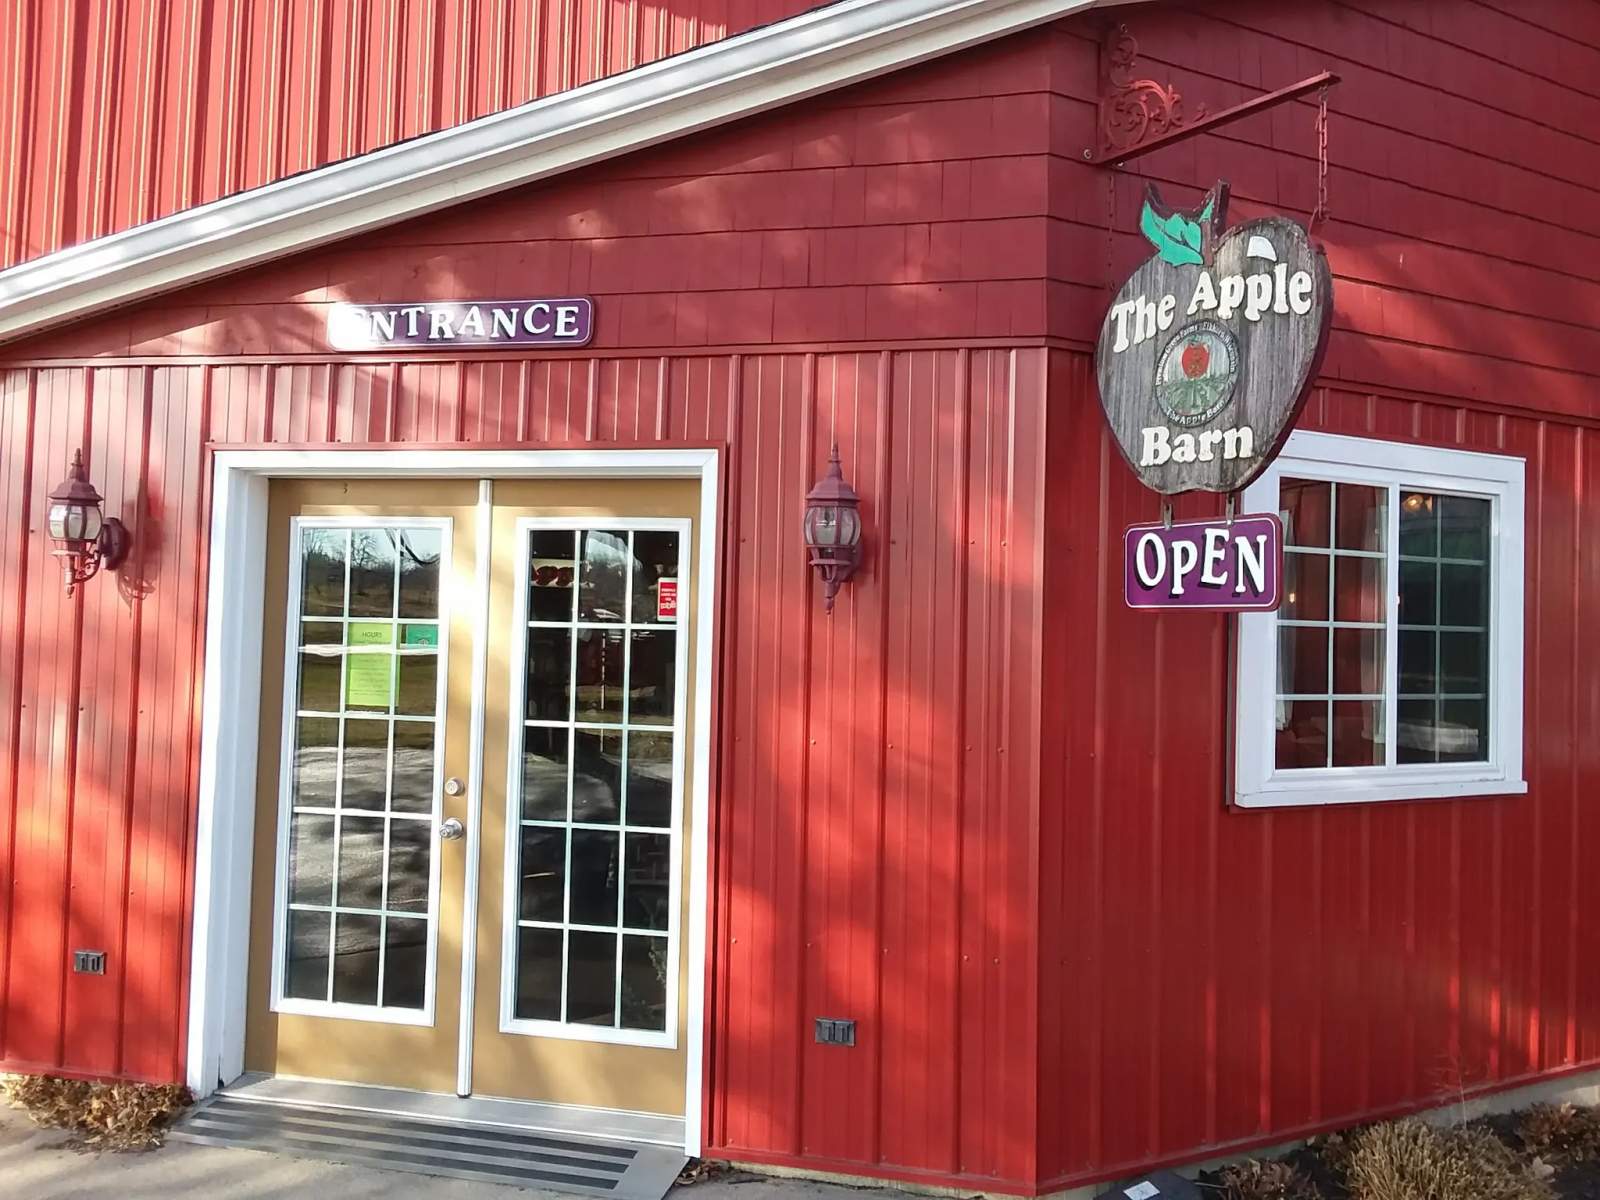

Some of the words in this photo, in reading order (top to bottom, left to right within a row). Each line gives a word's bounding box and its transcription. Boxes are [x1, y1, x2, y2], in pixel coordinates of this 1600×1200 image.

[1111, 294, 1176, 353] The
[1187, 263, 1313, 322] Apple
[1179, 414, 1206, 425] Apple
[1206, 400, 1225, 418] Barn
[1140, 426, 1253, 467] Barn
[1136, 528, 1267, 594] OPEN
